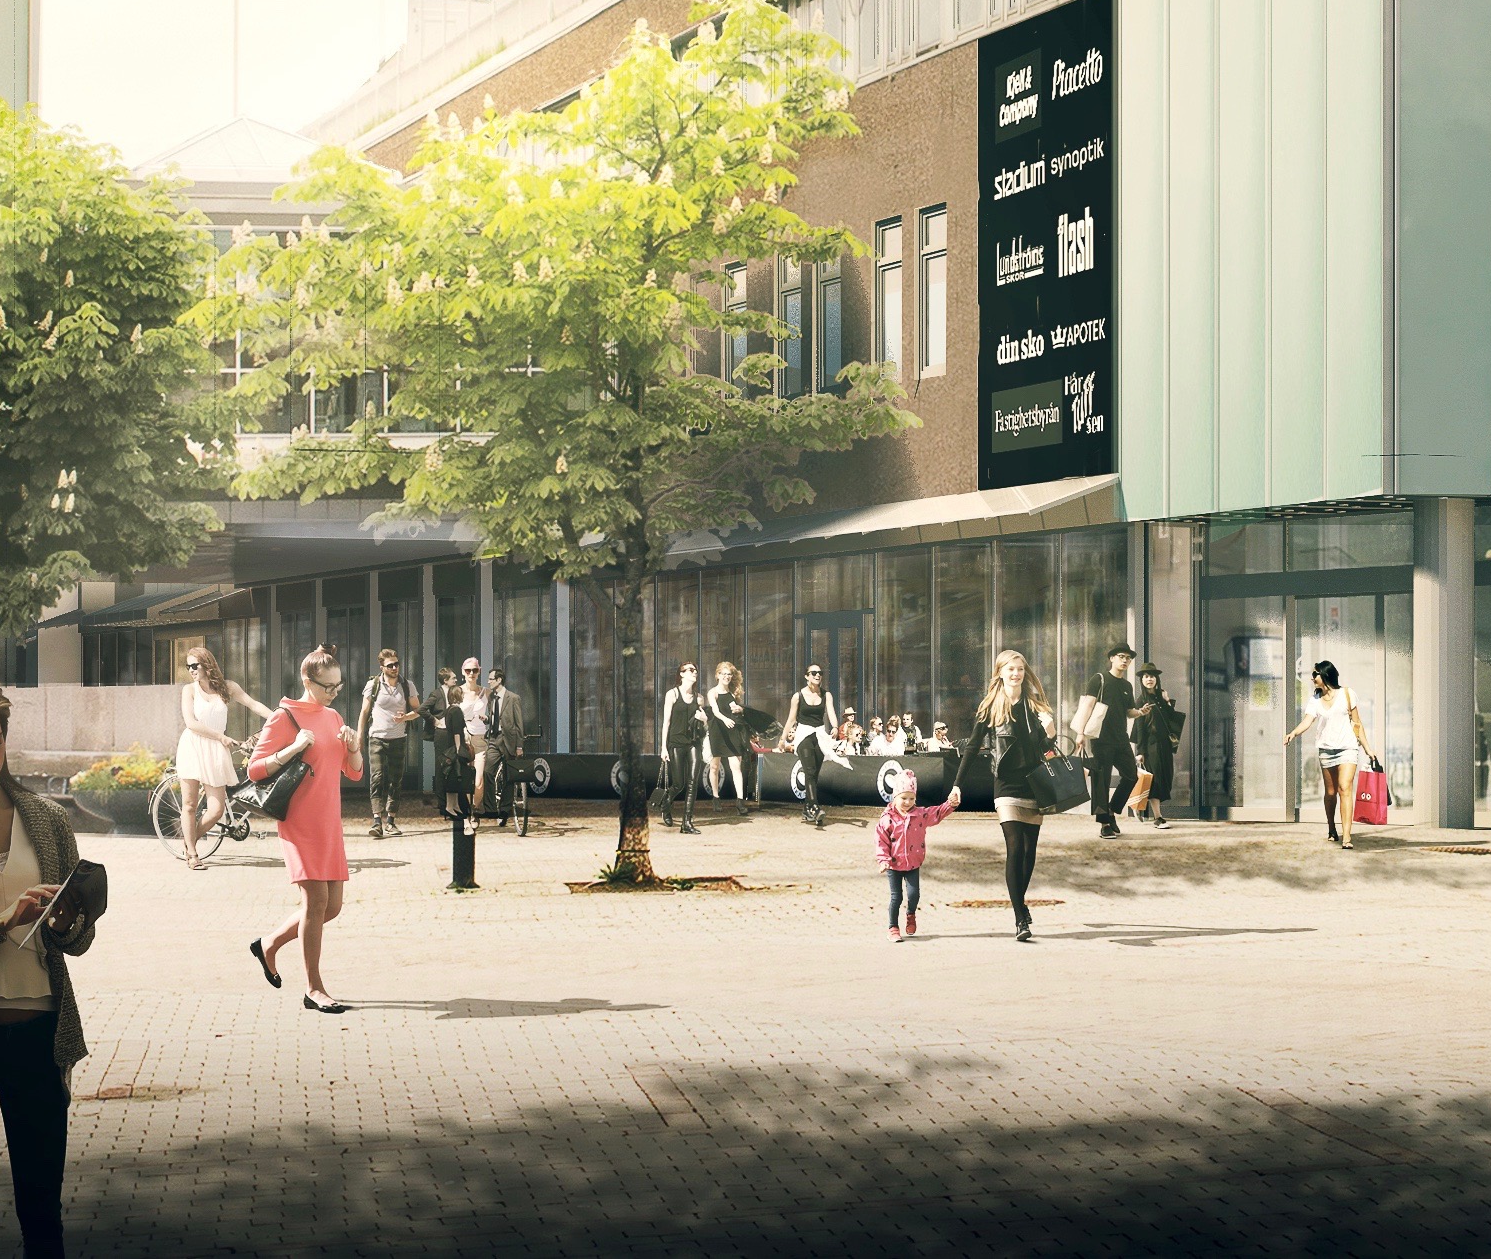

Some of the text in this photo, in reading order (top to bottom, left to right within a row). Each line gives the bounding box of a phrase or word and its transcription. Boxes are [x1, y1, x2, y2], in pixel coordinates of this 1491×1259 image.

[1006, 65, 1033, 100] Kjell &
[1051, 47, 1103, 100] Piacetto
[1050, 137, 1105, 178] synoptik
[1006, 271, 1025, 284] SKOR
[1066, 317, 1106, 347] APOTEK
[995, 402, 1060, 437] Fastighetsbyrån
